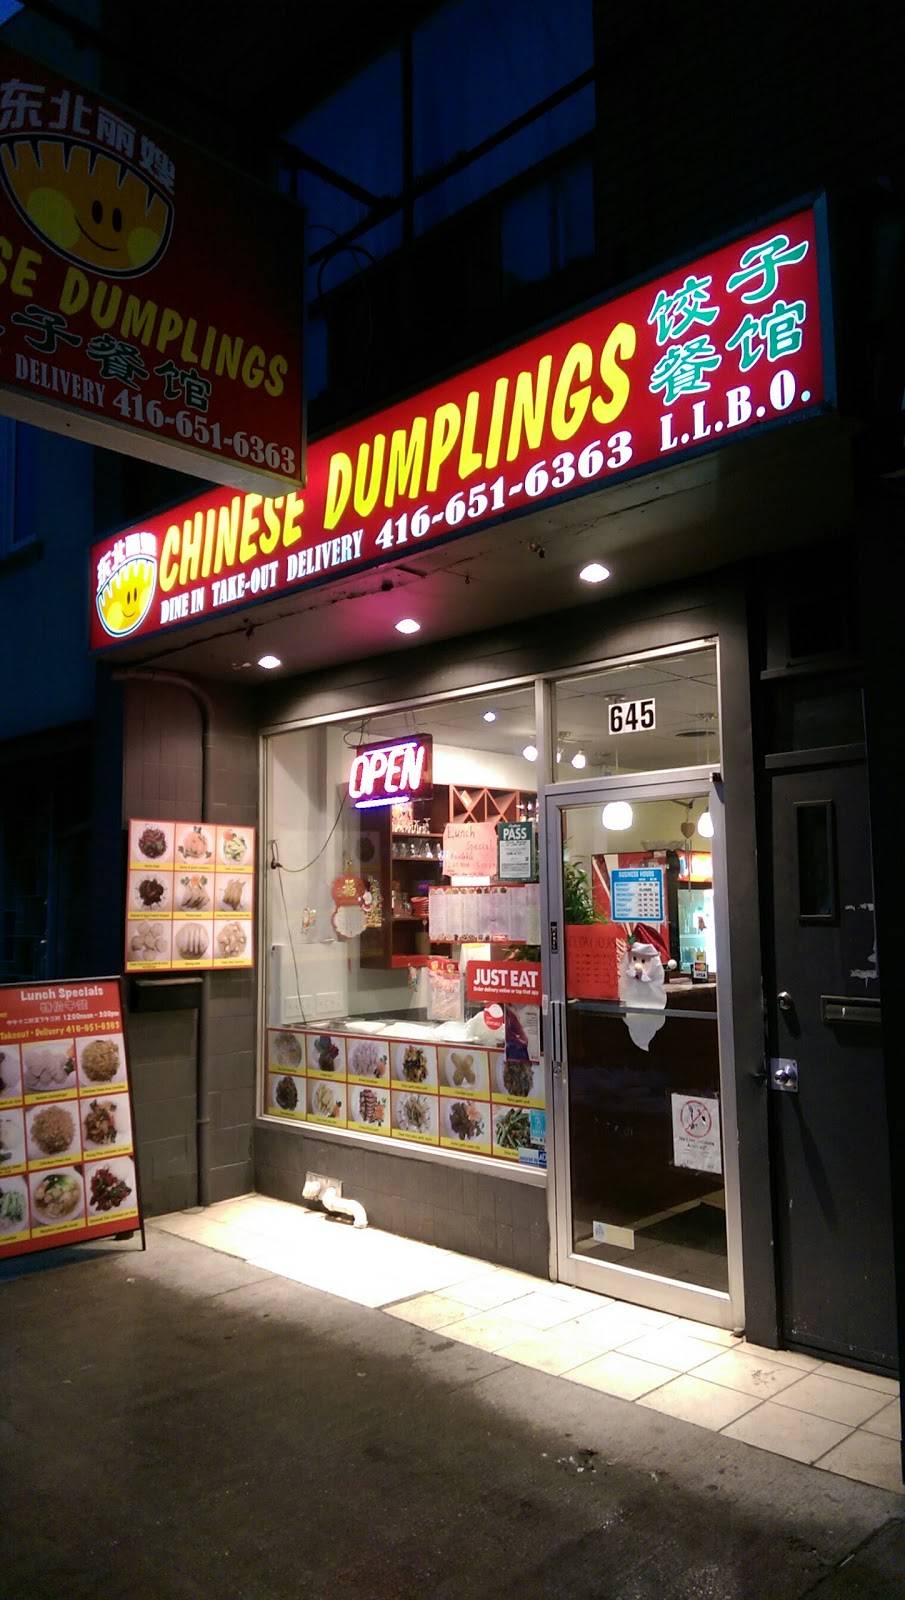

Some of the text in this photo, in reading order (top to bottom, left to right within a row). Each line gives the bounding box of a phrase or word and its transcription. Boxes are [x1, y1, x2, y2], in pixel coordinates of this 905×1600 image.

[59, 266, 289, 397] DUMPLINGS
[647, 234, 809, 346] 饺子
[0, 304, 212, 412] 子餐馆
[649, 300, 807, 406] 餐馆
[15, 353, 296, 474] DELIVERY 416-651-6363
[159, 322, 637, 592] CHINESE DUMPLINGS
[660, 369, 811, 451] L.L.B.O.
[160, 430, 634, 624] DINE IN TAKE-OUT DELIVERY 416-651-6363
[610, 700, 654, 732] 645
[349, 743, 425, 798] OPEN
[503, 827, 527, 840] PASS
[20, 985, 104, 1001] Lunch Specials
[473, 968, 538, 988] JUST EAT
[35, 1026, 64, 1038] Delivery
